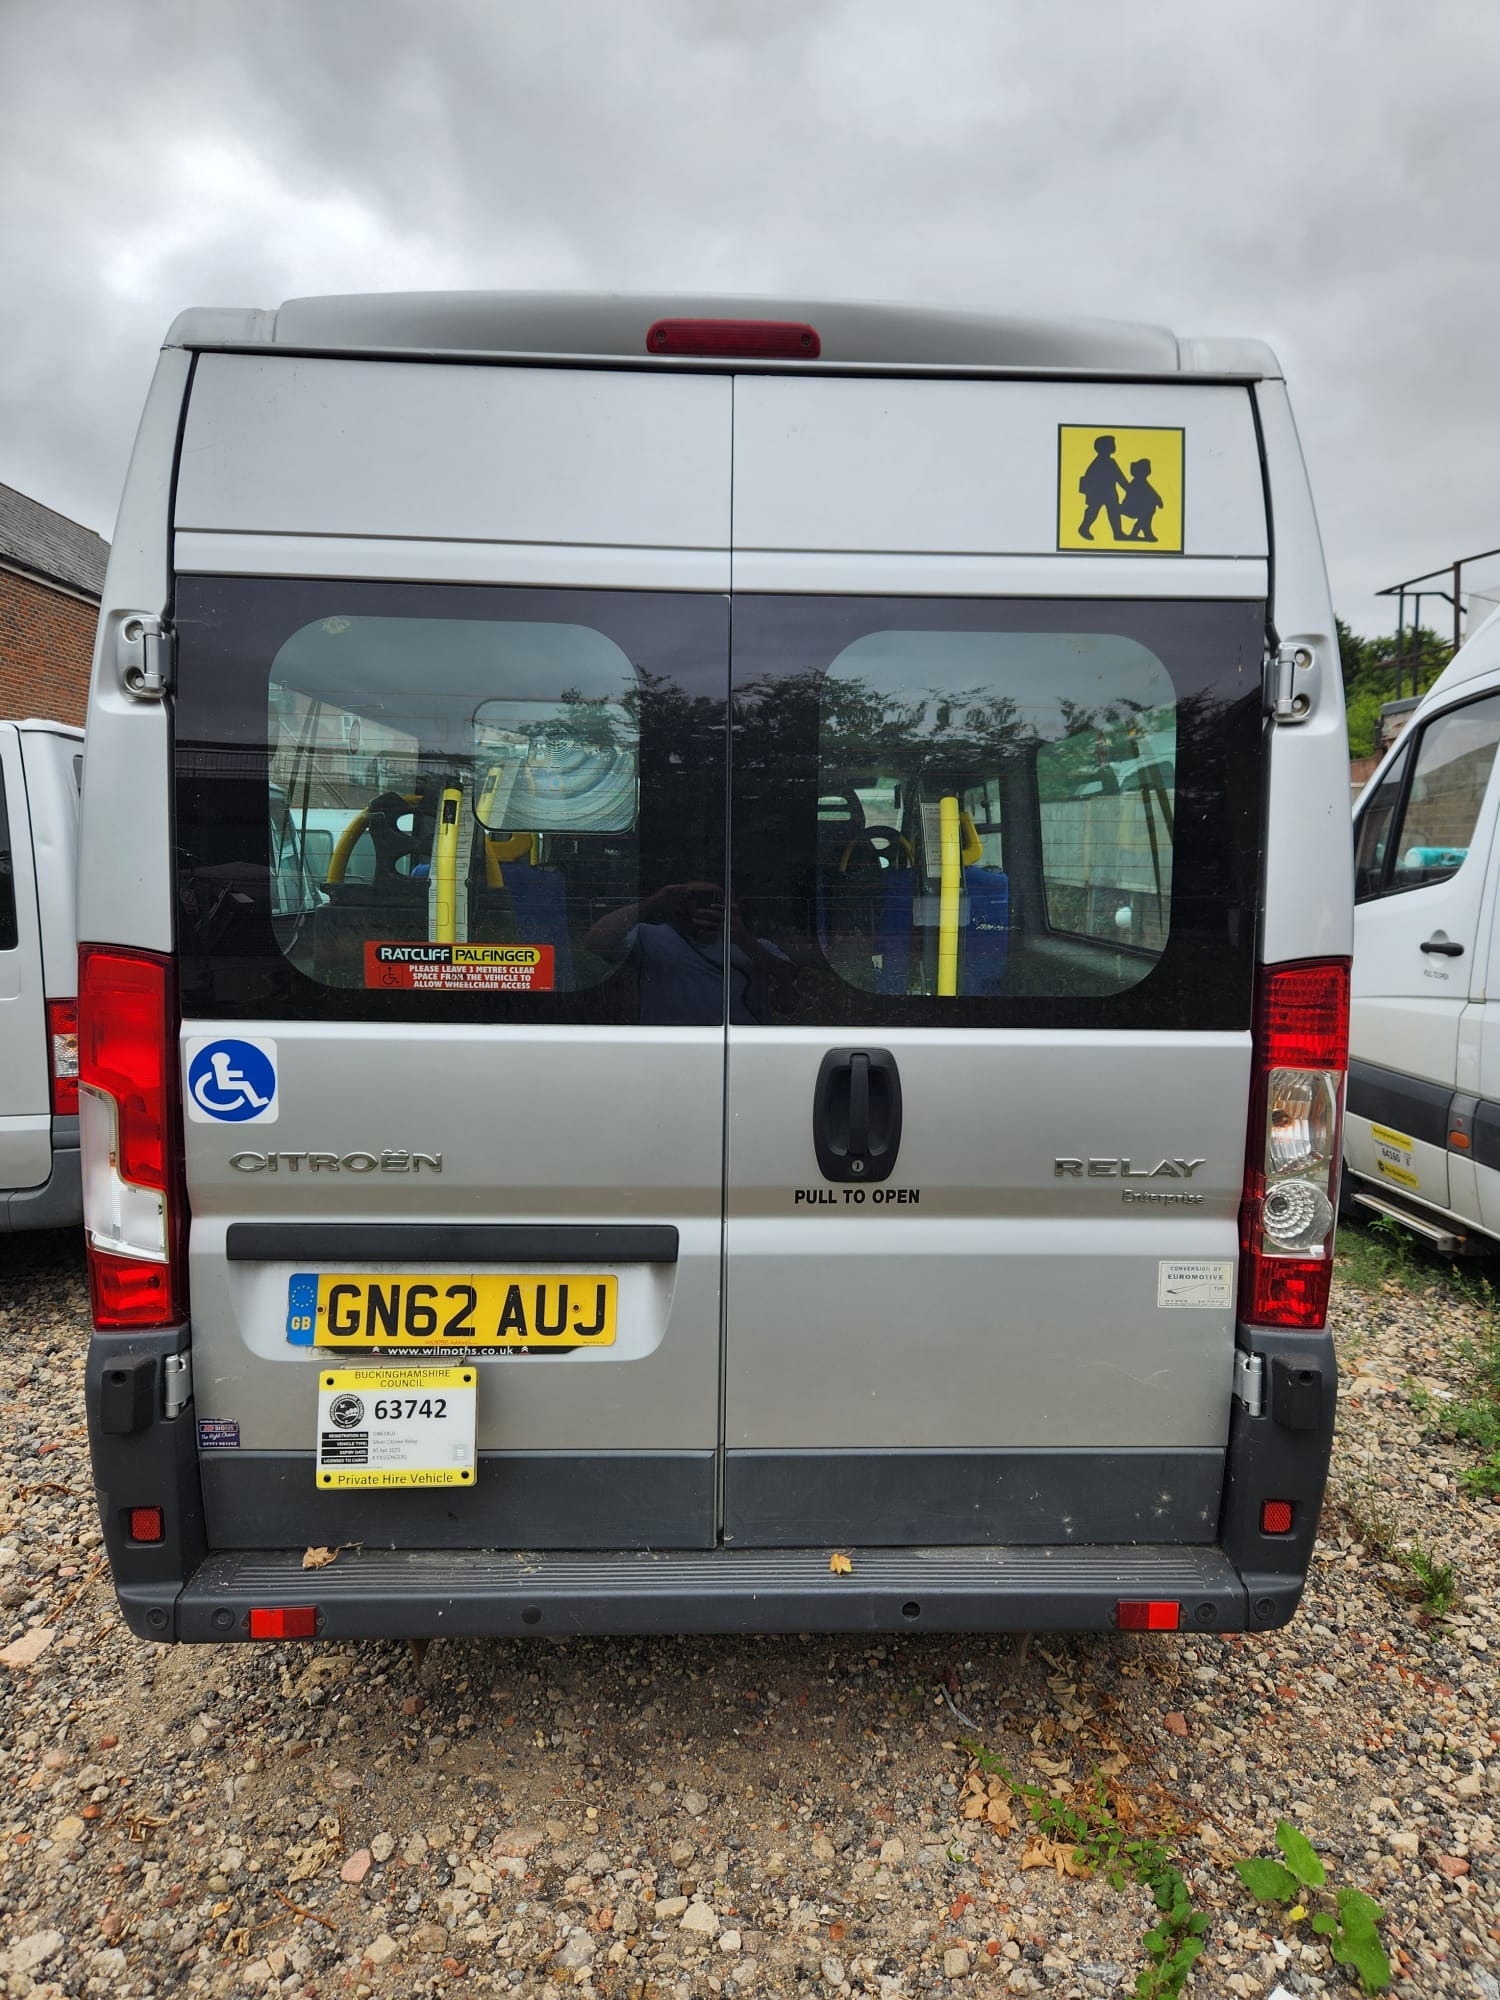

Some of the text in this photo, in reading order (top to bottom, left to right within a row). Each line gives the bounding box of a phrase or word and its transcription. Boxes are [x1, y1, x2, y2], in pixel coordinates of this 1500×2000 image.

[380, 947, 535, 962] RATCLIFF PALFINGER
[409, 965, 535, 975] PLEASE LEAVE 3 METRES CLEAR
[412, 973, 532, 982] SPACE FROM THE VEHICLE TO
[413, 980, 443, 988] ALLOW
[444, 981, 499, 989] WHEELCHAIR
[500, 982, 531, 990] ACCESS
[229, 1149, 443, 1173] CITROËN
[1054, 1157, 1207, 1178] RELAY
[794, 1189, 921, 1204] PULL TO OPEN
[1121, 1188, 1205, 1207] Enterprise
[1167, 1273, 1225, 1281] EUROMOTIVE
[327, 1283, 607, 1337] GN62 AUJ
[290, 1316, 311, 1331] GB
[387, 1345, 514, 1356] www.wilmoths.co.uk
[355, 1369, 451, 1379] BUCKINGHAMSHIRE
[380, 1379, 425, 1388] COUNCIL
[374, 1398, 448, 1420] 63742
[338, 1472, 454, 1485] Private Hire Vehicle
